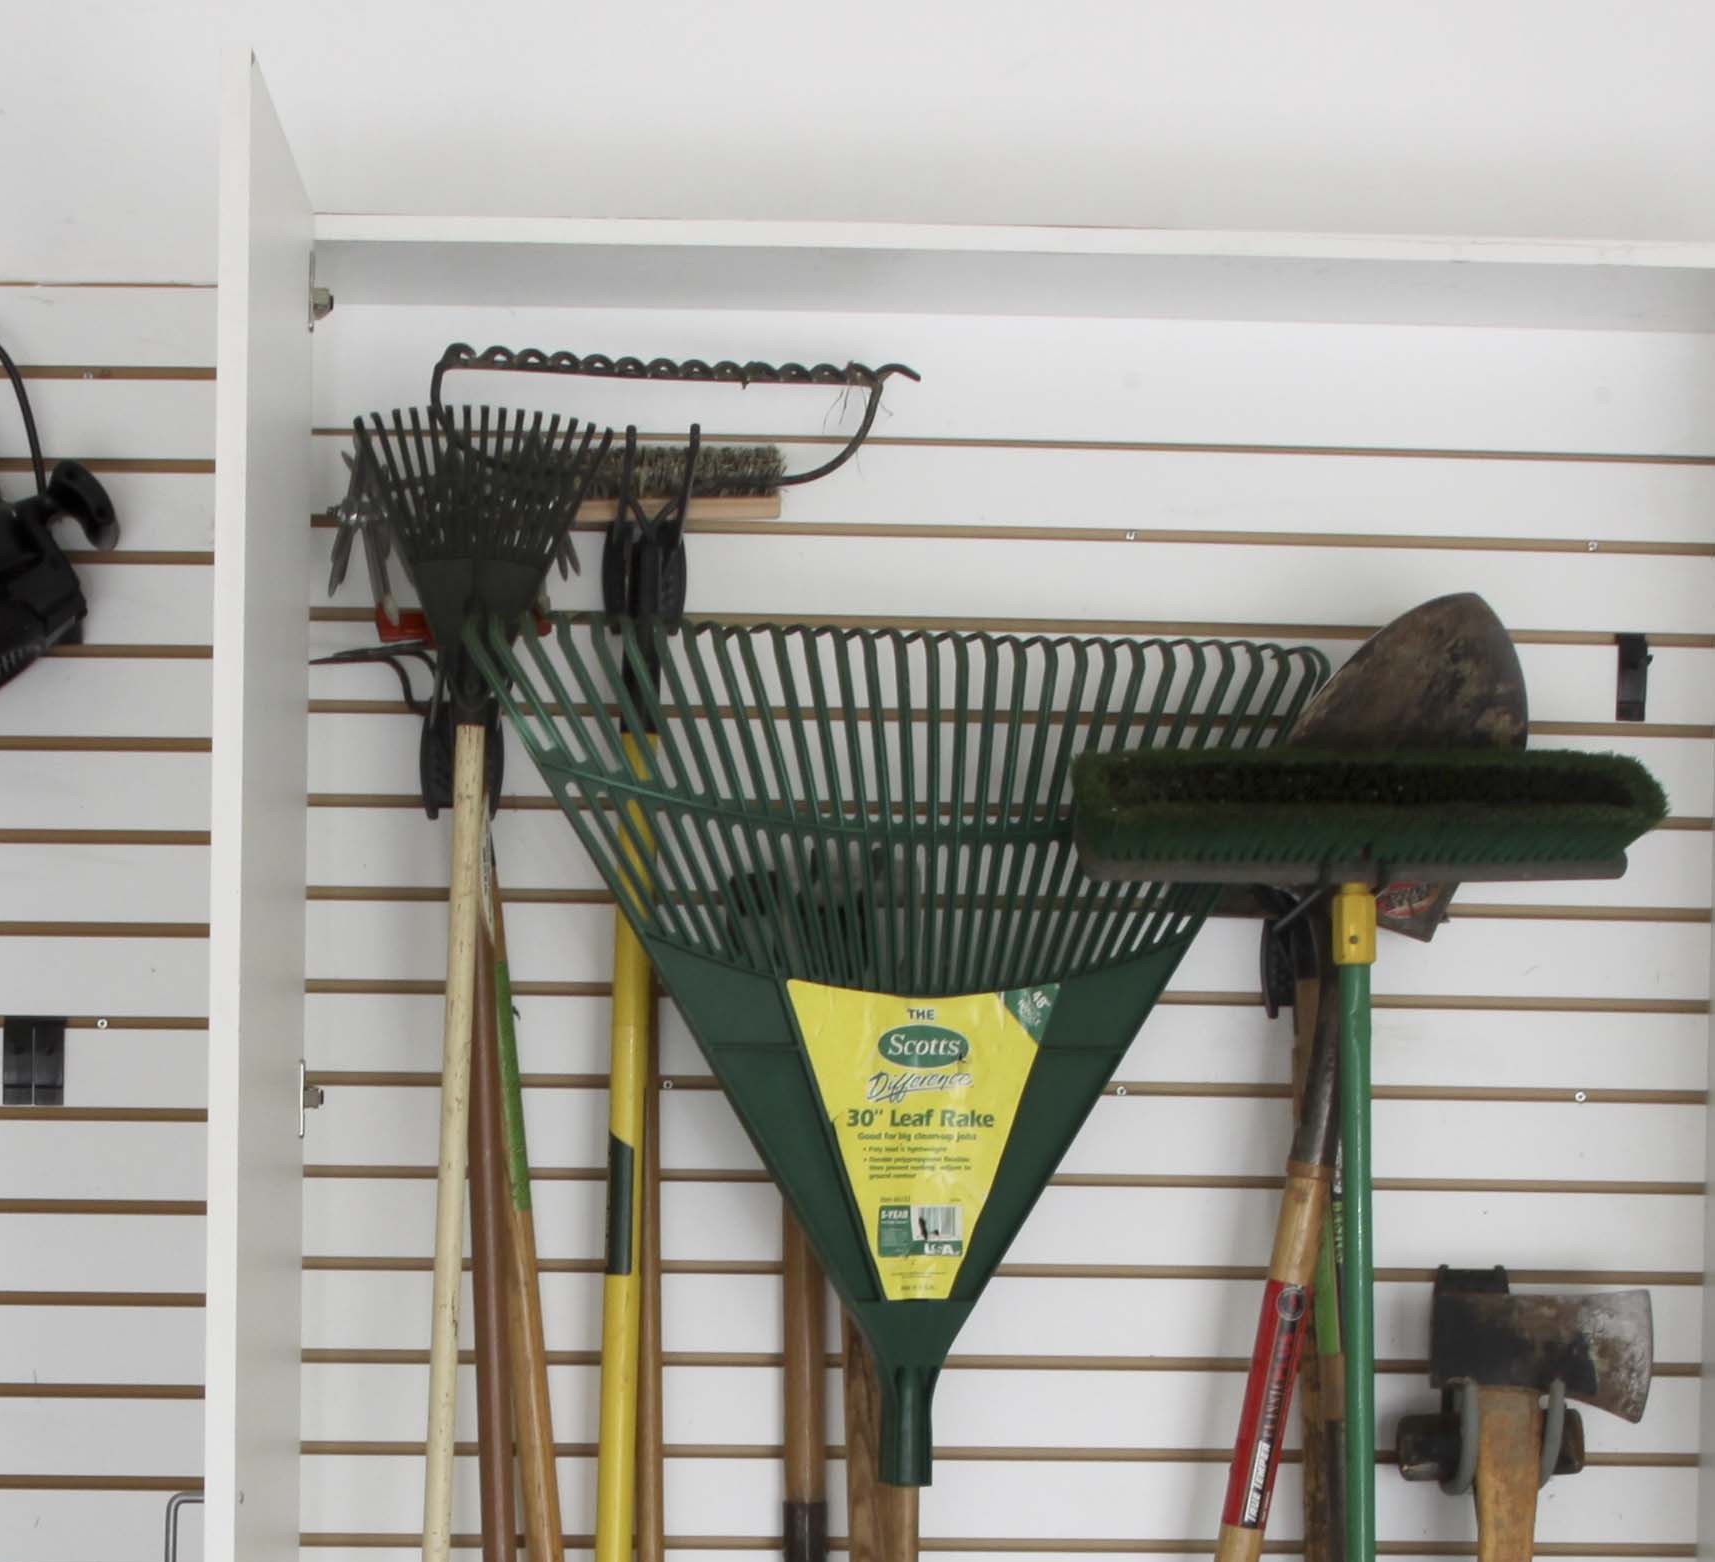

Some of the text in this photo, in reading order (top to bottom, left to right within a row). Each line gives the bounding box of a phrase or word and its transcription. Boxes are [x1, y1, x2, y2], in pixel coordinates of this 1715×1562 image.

[907, 1008, 935, 1020] THE
[887, 1033, 961, 1056] Scotts
[866, 1071, 973, 1103] Difference
[846, 1108, 995, 1127] 30" Leaf Rake
[857, 1132, 882, 1140] Good
